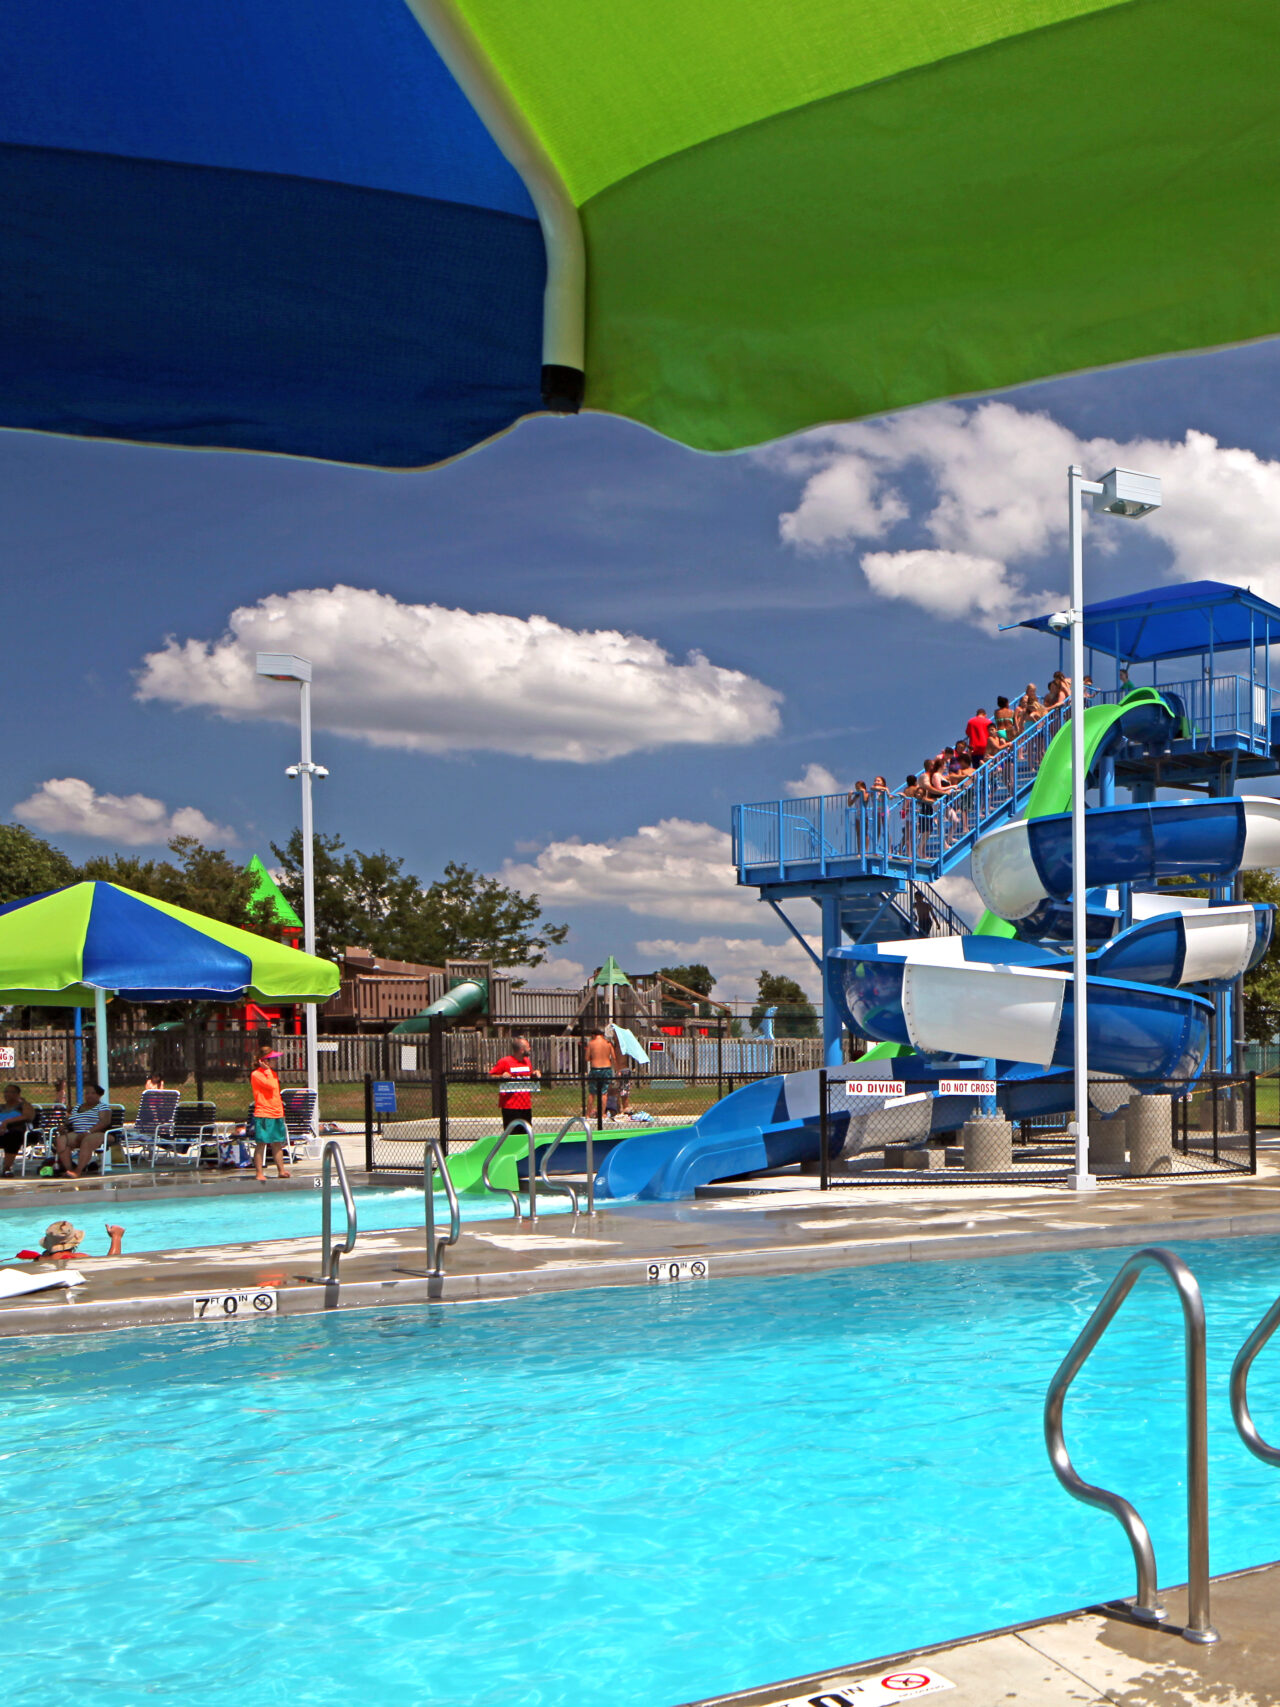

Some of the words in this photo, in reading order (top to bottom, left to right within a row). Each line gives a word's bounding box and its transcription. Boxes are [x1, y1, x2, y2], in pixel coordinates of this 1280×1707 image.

[848, 1083, 863, 1093] NO
[867, 1083, 903, 1094] DIVING
[940, 1082, 951, 1092] DO
[953, 1082, 969, 1092] NOT
[970, 1083, 995, 1093] CROSS
[648, 1264, 660, 1280] 9
[669, 1262, 680, 1278] 0
[195, 1298, 210, 1318] 7
[223, 1296, 238, 1314] 0
[238, 1294, 248, 1302] IN
[840, 1686, 865, 1696] IN
